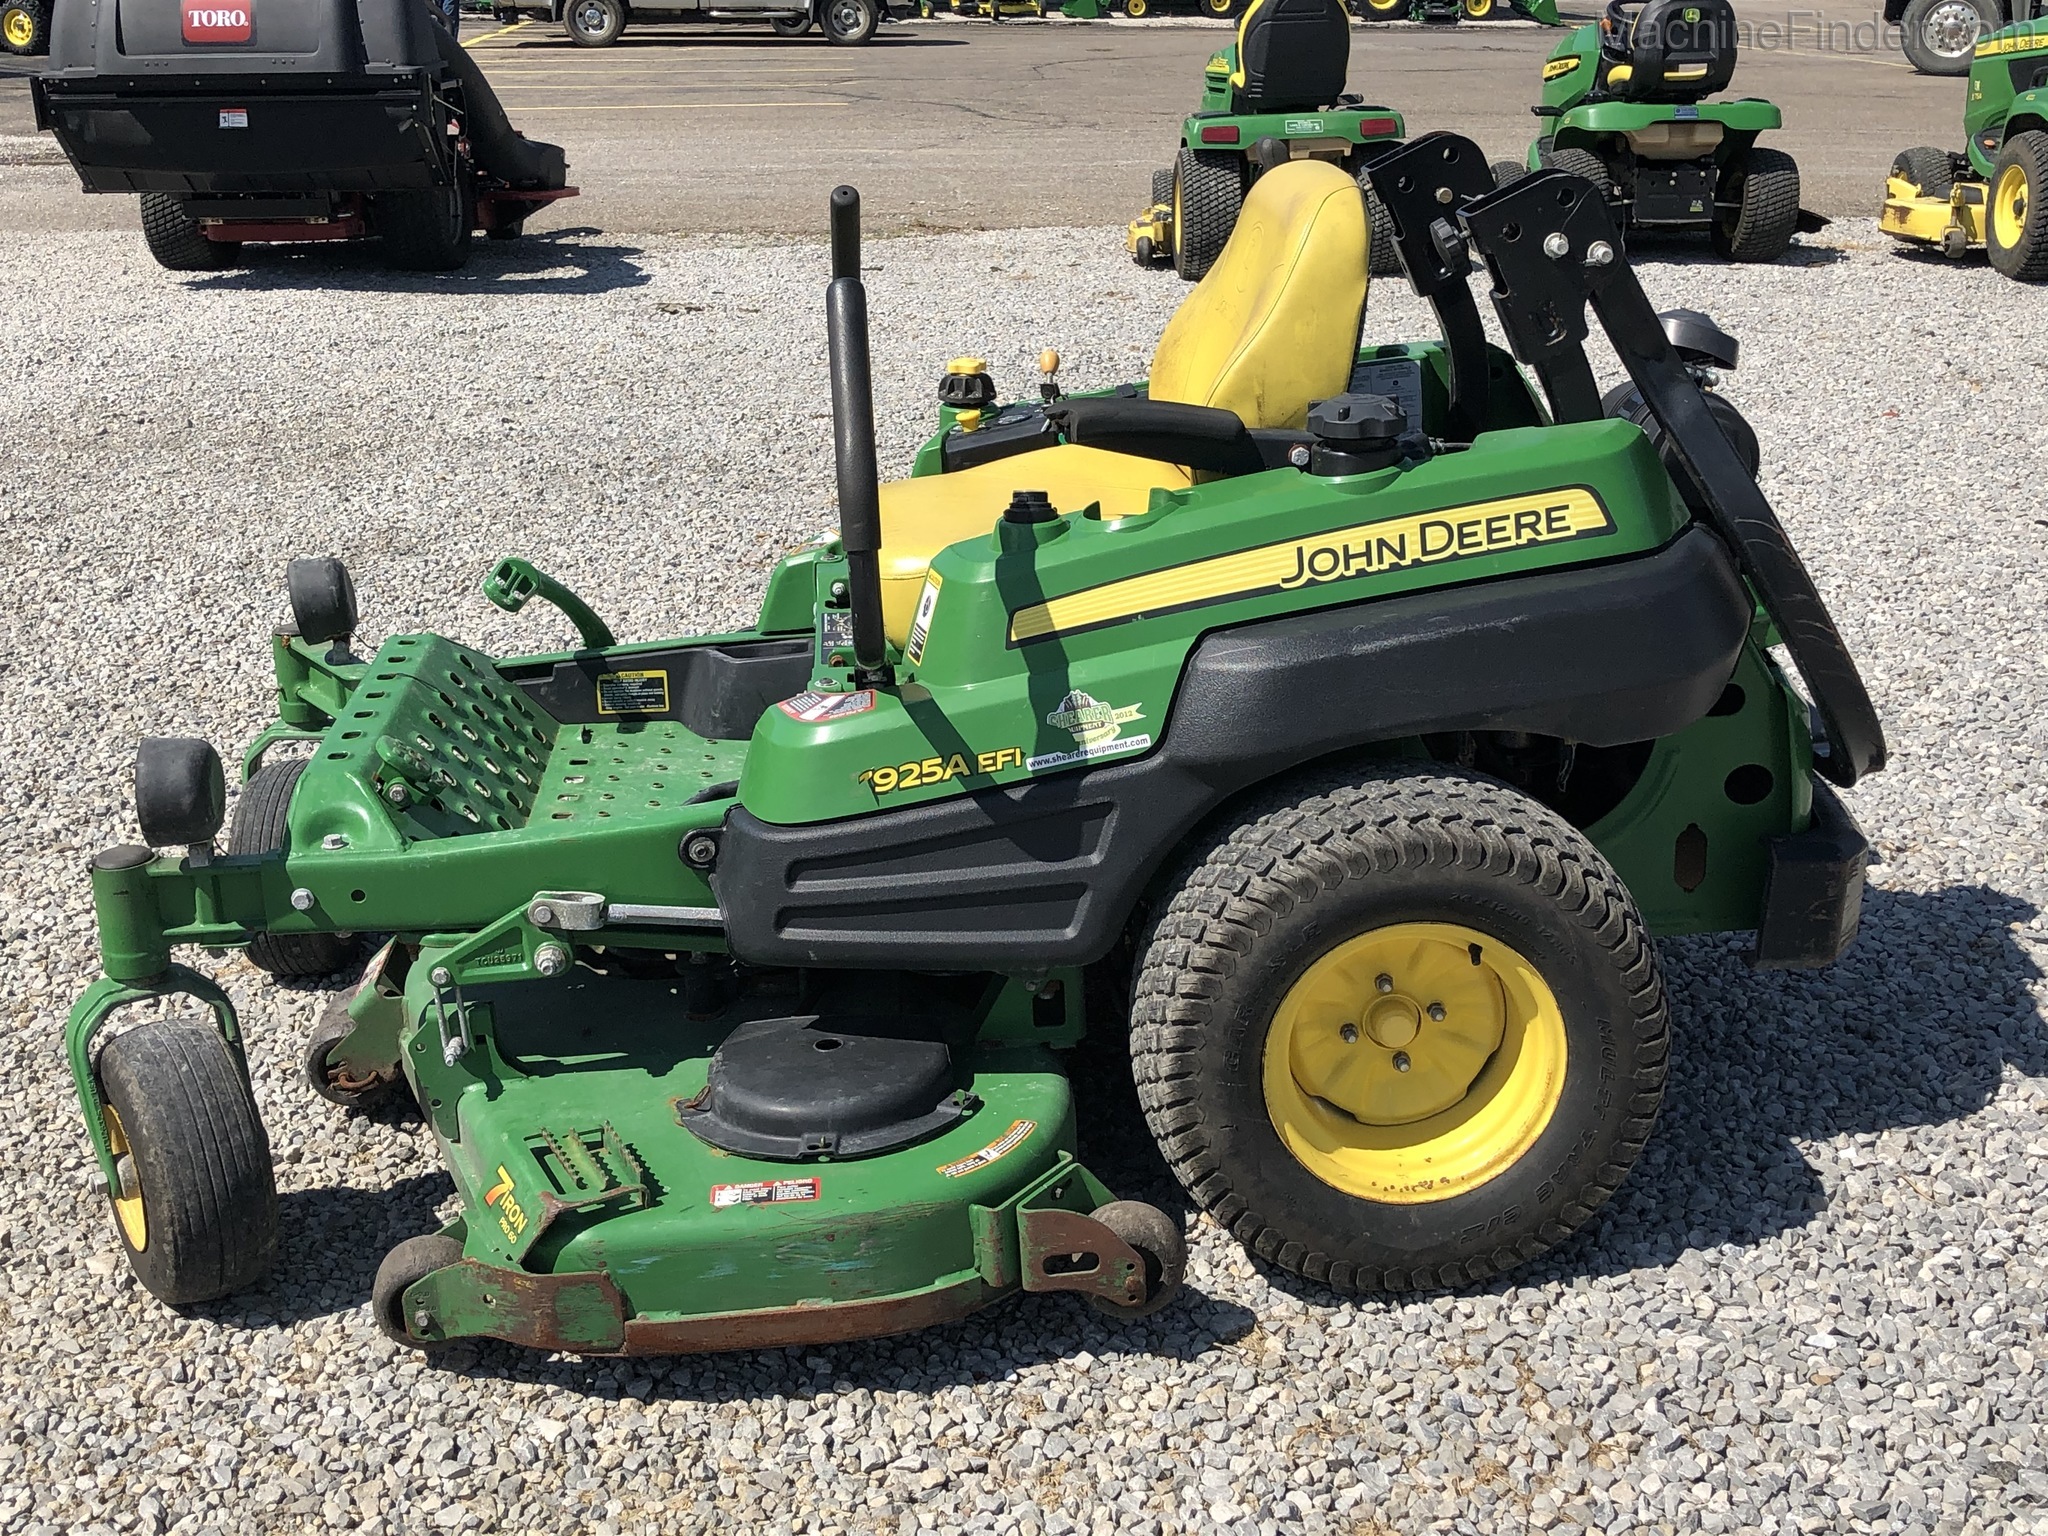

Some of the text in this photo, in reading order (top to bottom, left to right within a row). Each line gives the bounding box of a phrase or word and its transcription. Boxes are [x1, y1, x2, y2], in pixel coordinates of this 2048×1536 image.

[188, 10, 246, 27] TORO
[1281, 504, 1571, 585] JOHN DEERE
[1049, 703, 1114, 728] SHEARER
[1115, 710, 1133, 720] 2012
[978, 748, 1022, 774] EFI
[498, 1216, 517, 1245] PRO 60
